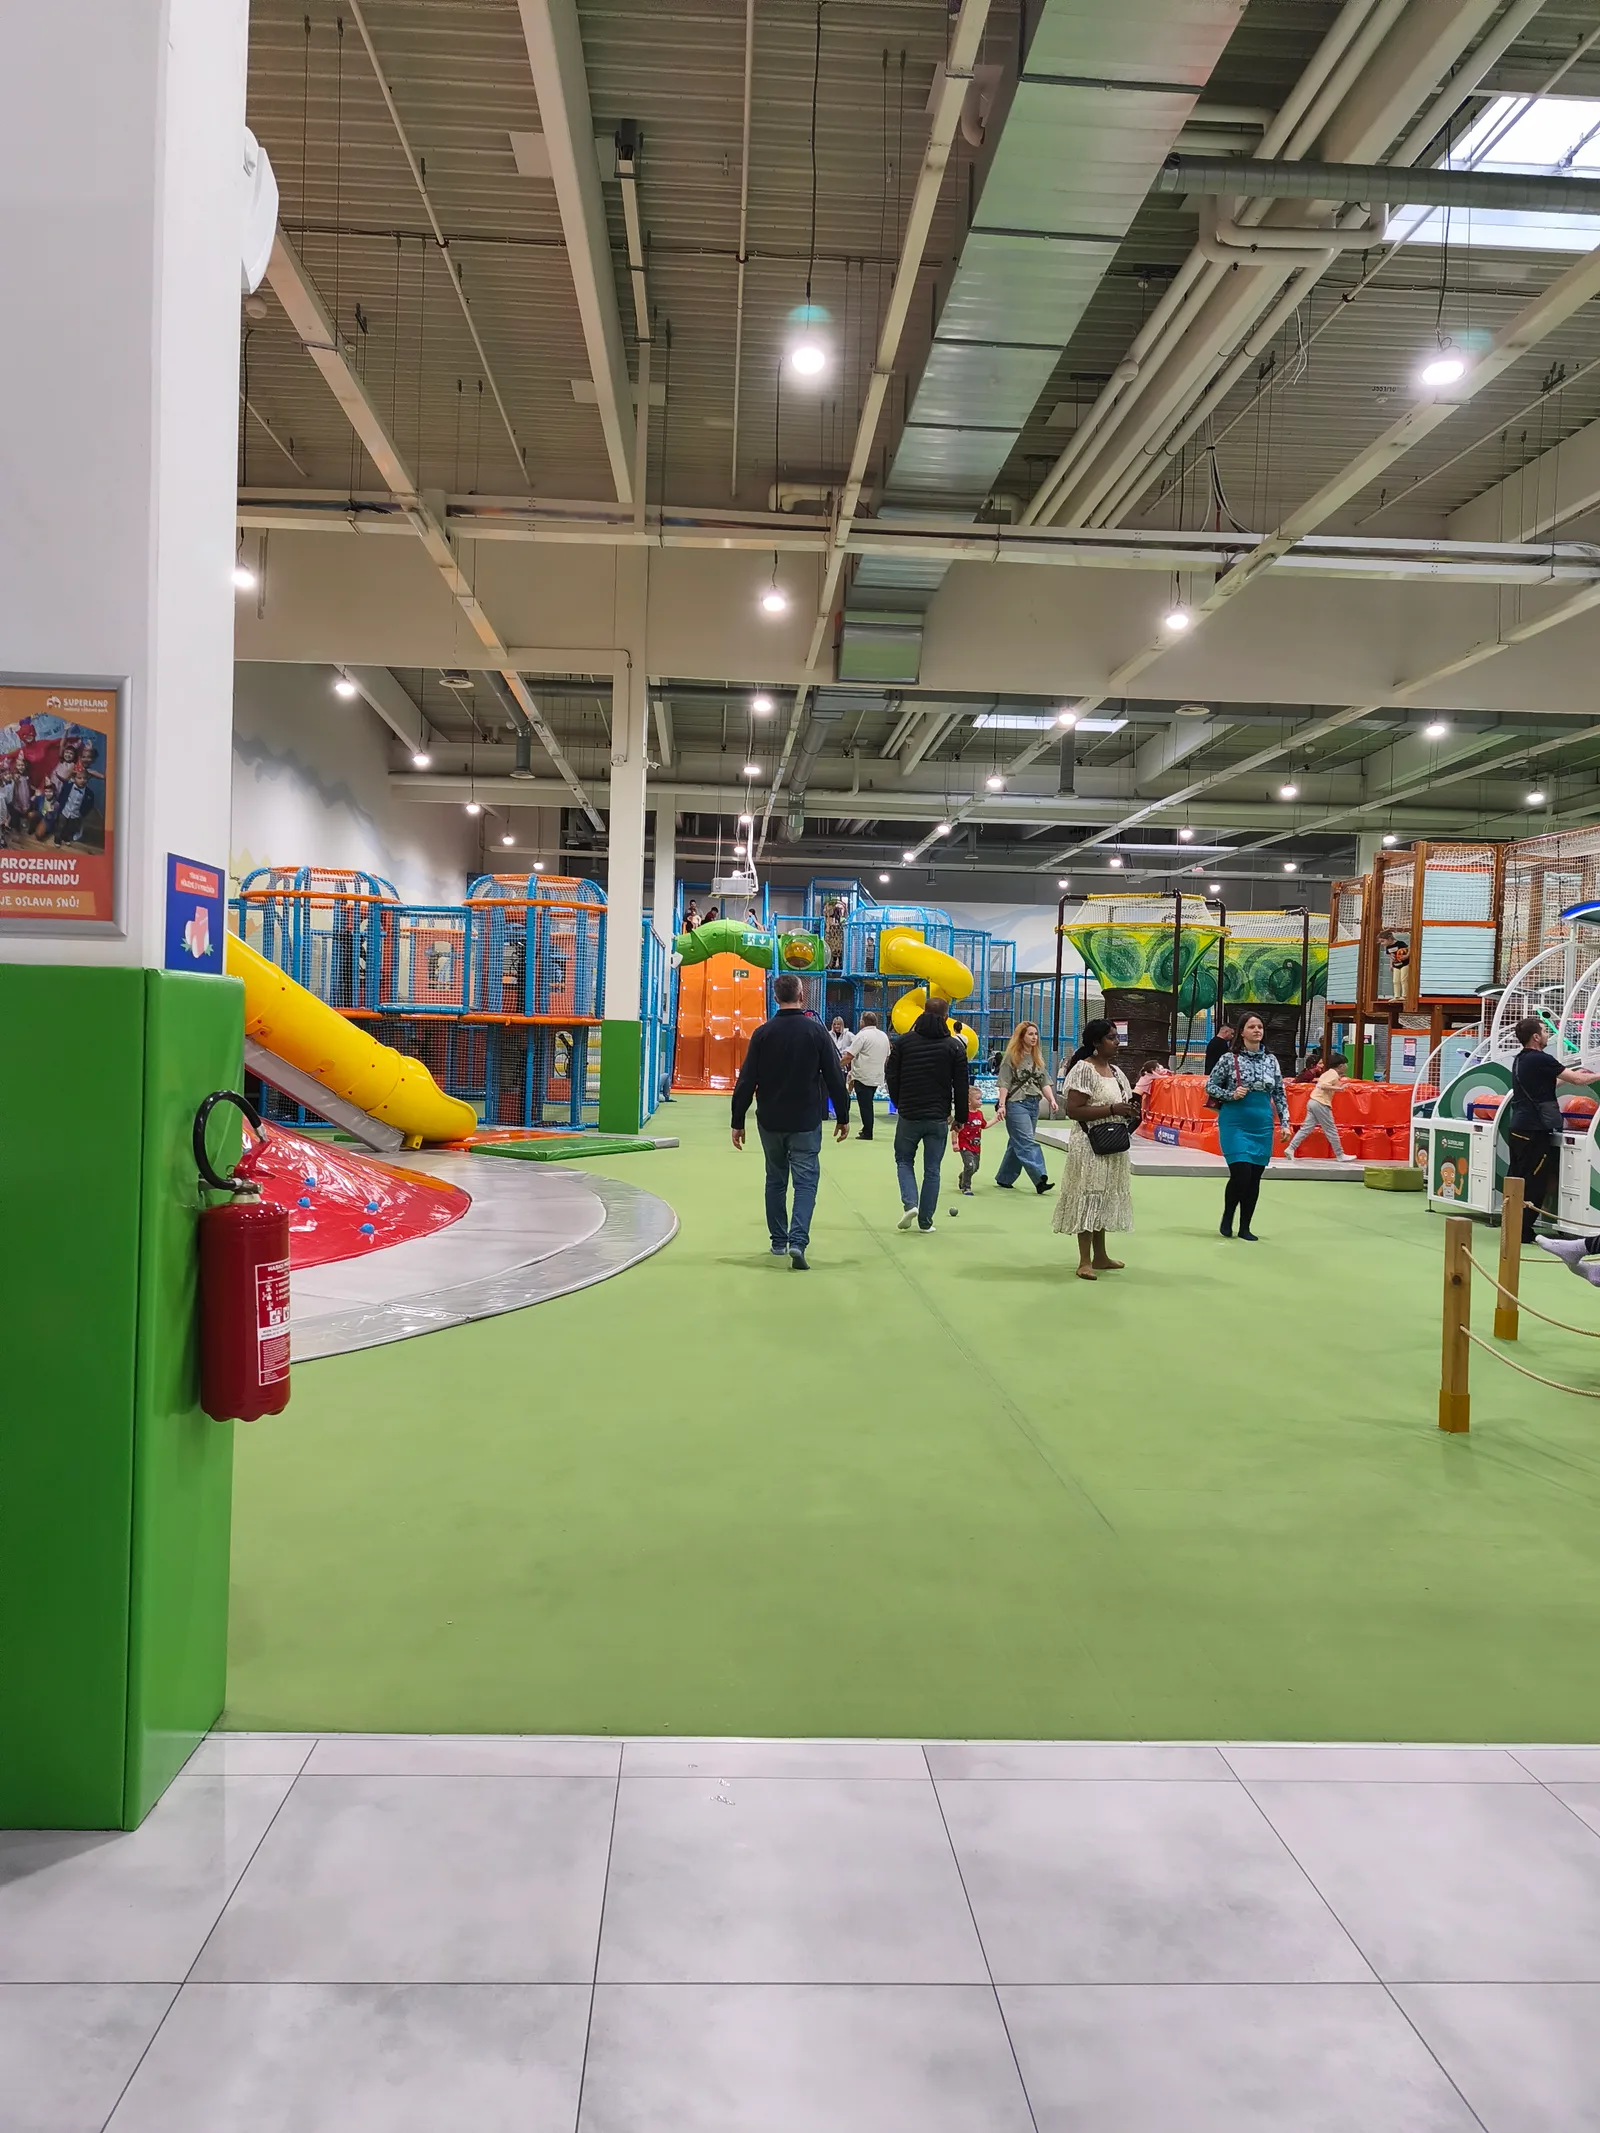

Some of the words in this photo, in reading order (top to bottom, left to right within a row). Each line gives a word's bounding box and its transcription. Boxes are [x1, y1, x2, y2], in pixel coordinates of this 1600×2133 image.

[63, 698, 108, 707] SUPERLAND
[0, 857, 77, 870] AROZENINY
[2, 872, 79, 885] SUPERLANDU
[15, 896, 53, 907] OSLAVA
[56, 895, 80, 908] SNŮ!
